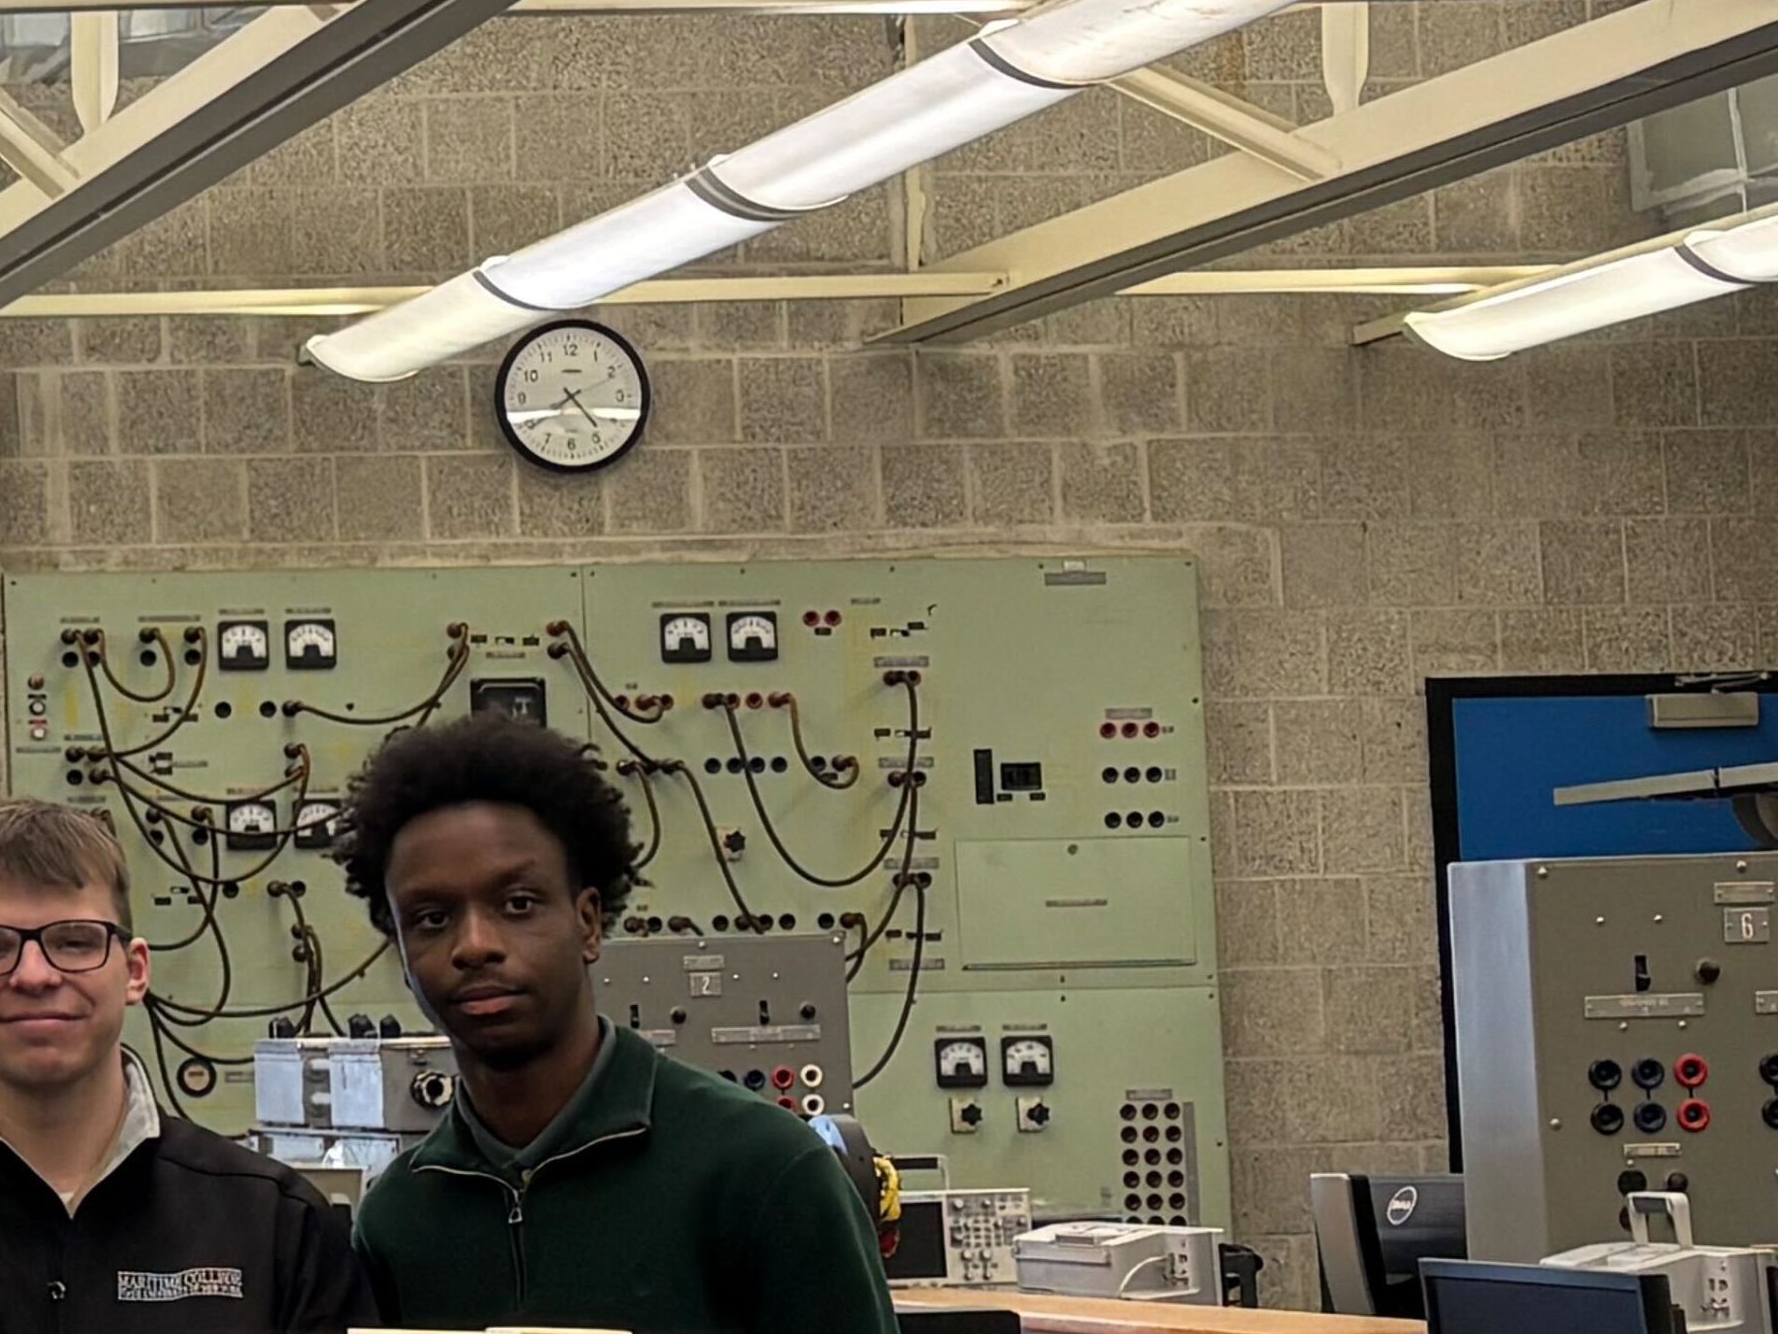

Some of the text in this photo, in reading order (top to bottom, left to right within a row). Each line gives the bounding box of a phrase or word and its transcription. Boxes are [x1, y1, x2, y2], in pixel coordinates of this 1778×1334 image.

[540, 351, 552, 363] 11
[563, 343, 578, 357] 12
[524, 369, 538, 383] 10
[606, 365, 616, 379] 2
[517, 390, 527, 405] 9
[544, 431, 552, 445] 7
[567, 436, 577, 451] 6
[1740, 912, 1754, 939] 6
[701, 975, 711, 995] 2
